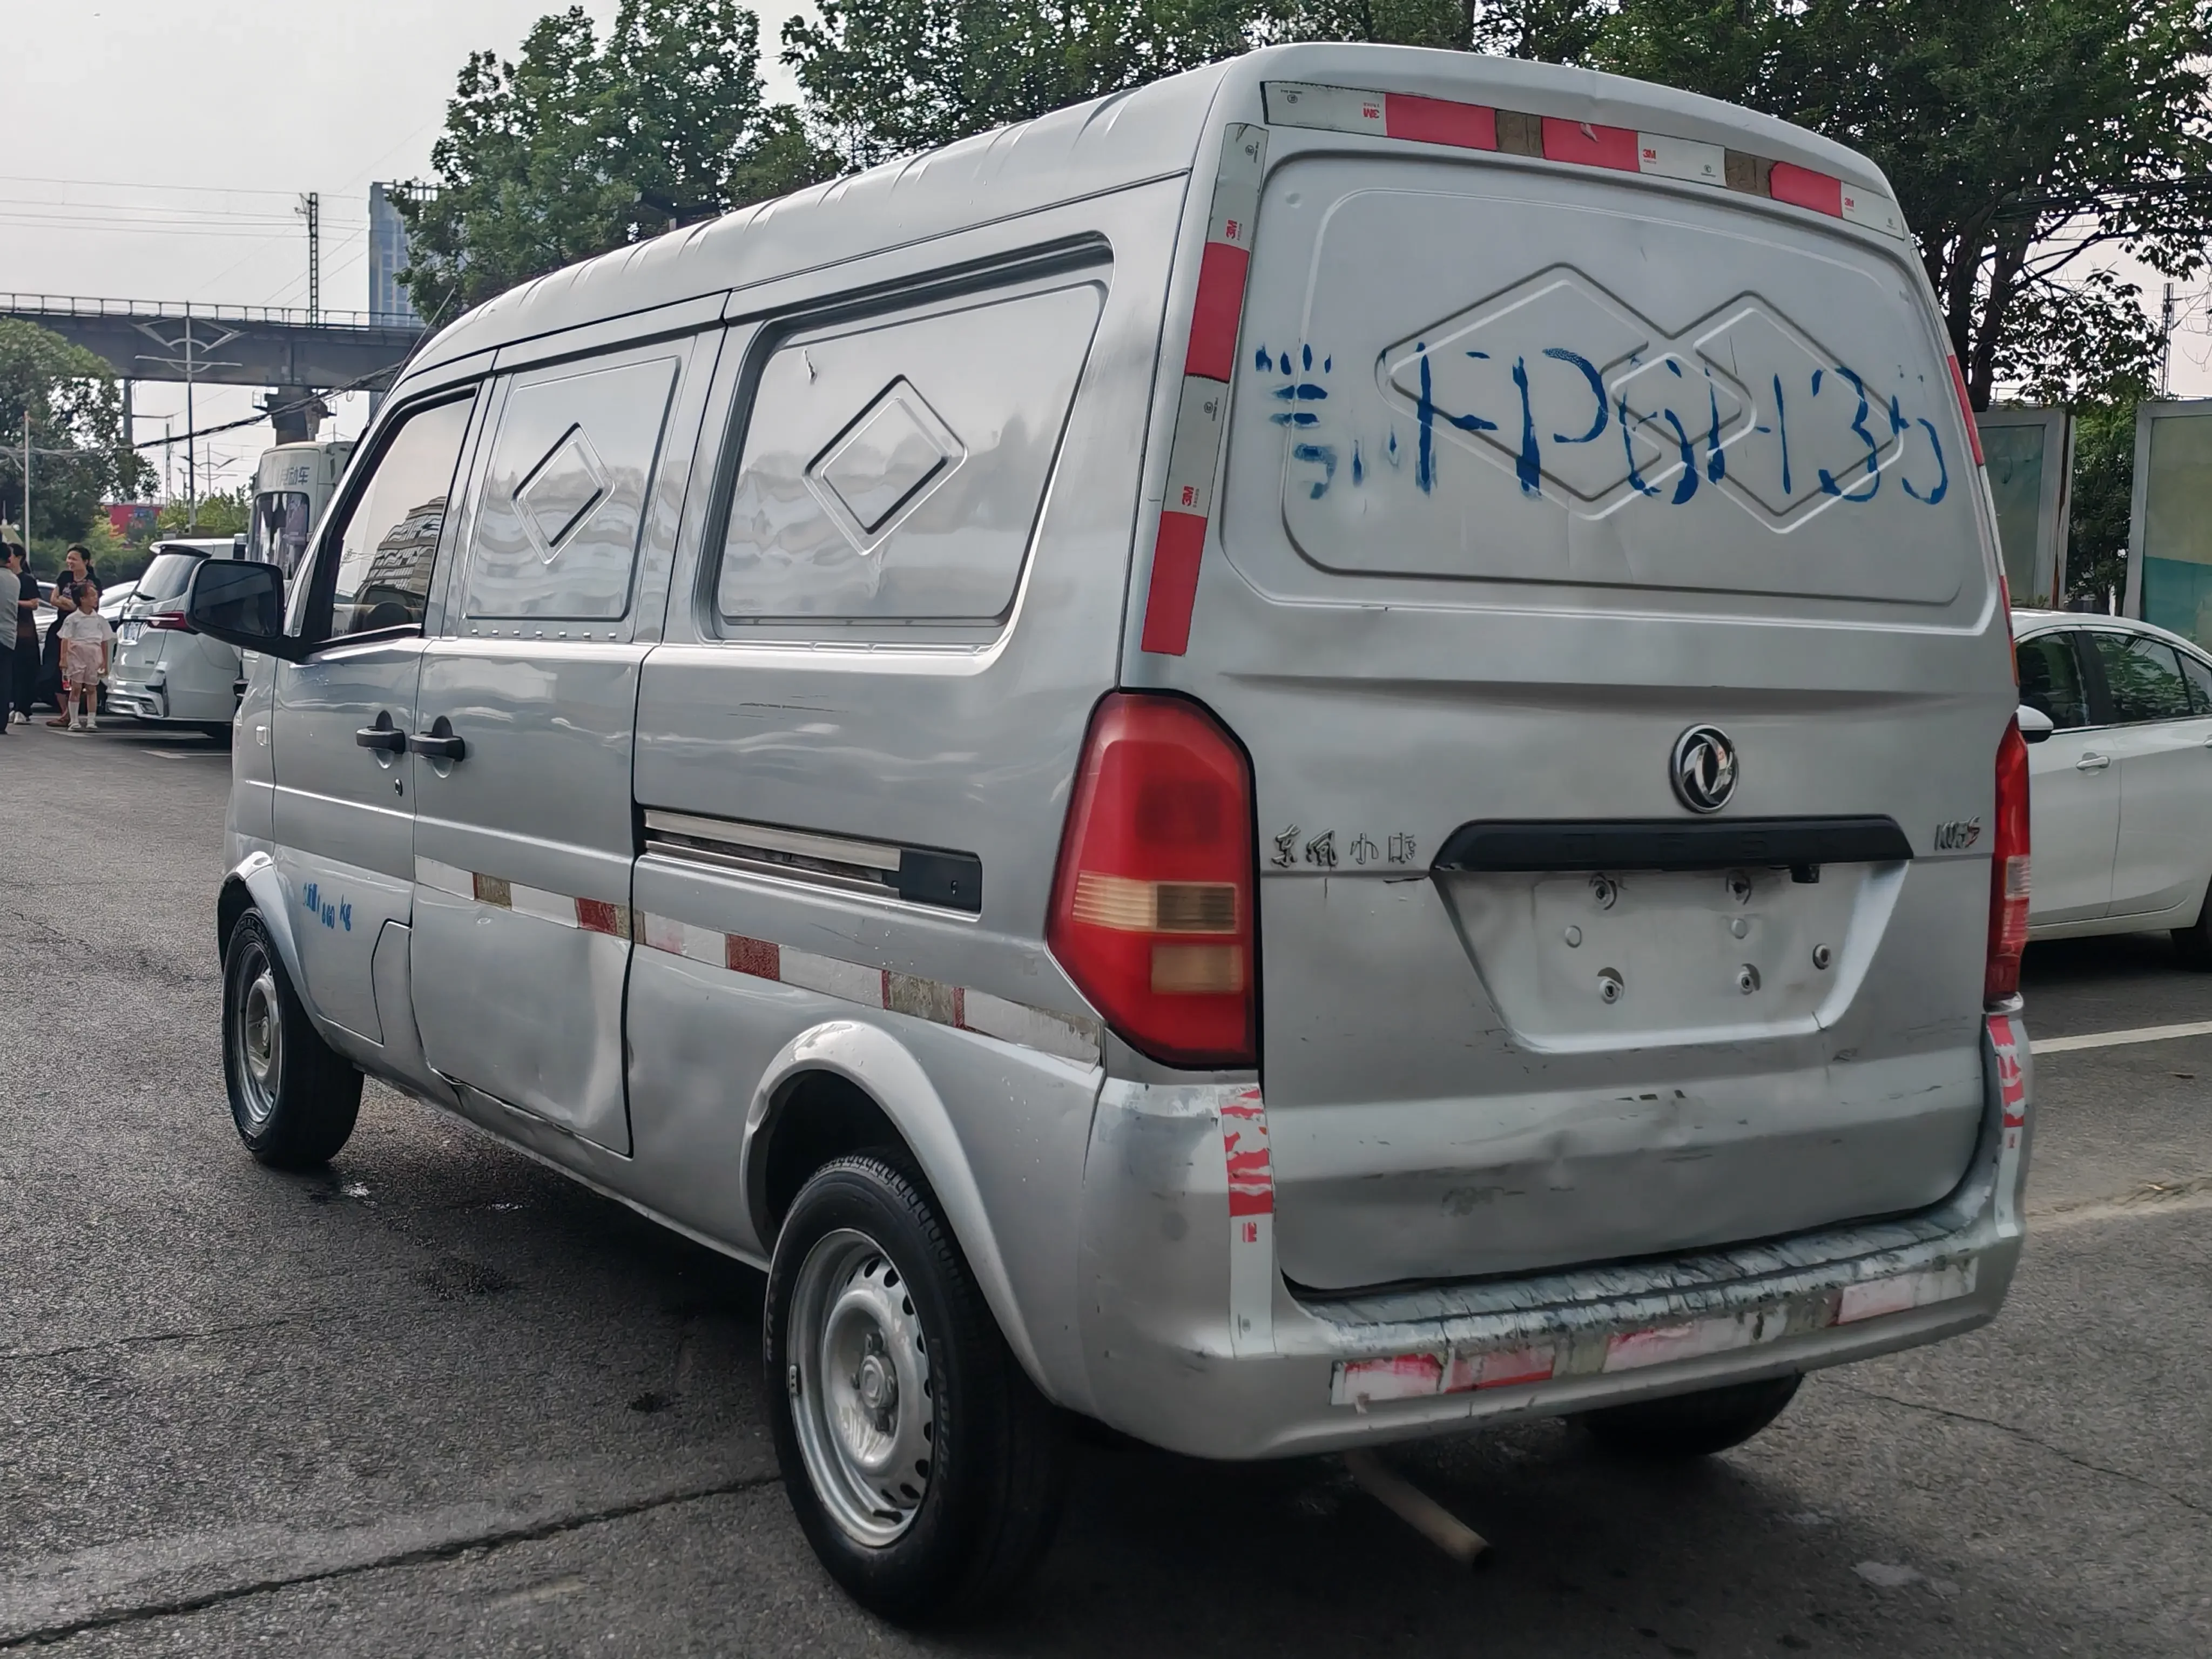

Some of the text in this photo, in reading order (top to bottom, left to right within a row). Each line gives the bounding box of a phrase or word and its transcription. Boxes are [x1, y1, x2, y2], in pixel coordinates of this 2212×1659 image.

[1363, 107, 1380, 119] 3M
[1642, 149, 1656, 160] 3M
[1226, 219, 1237, 239] 3M
[1182, 485, 1195, 507] 3M
